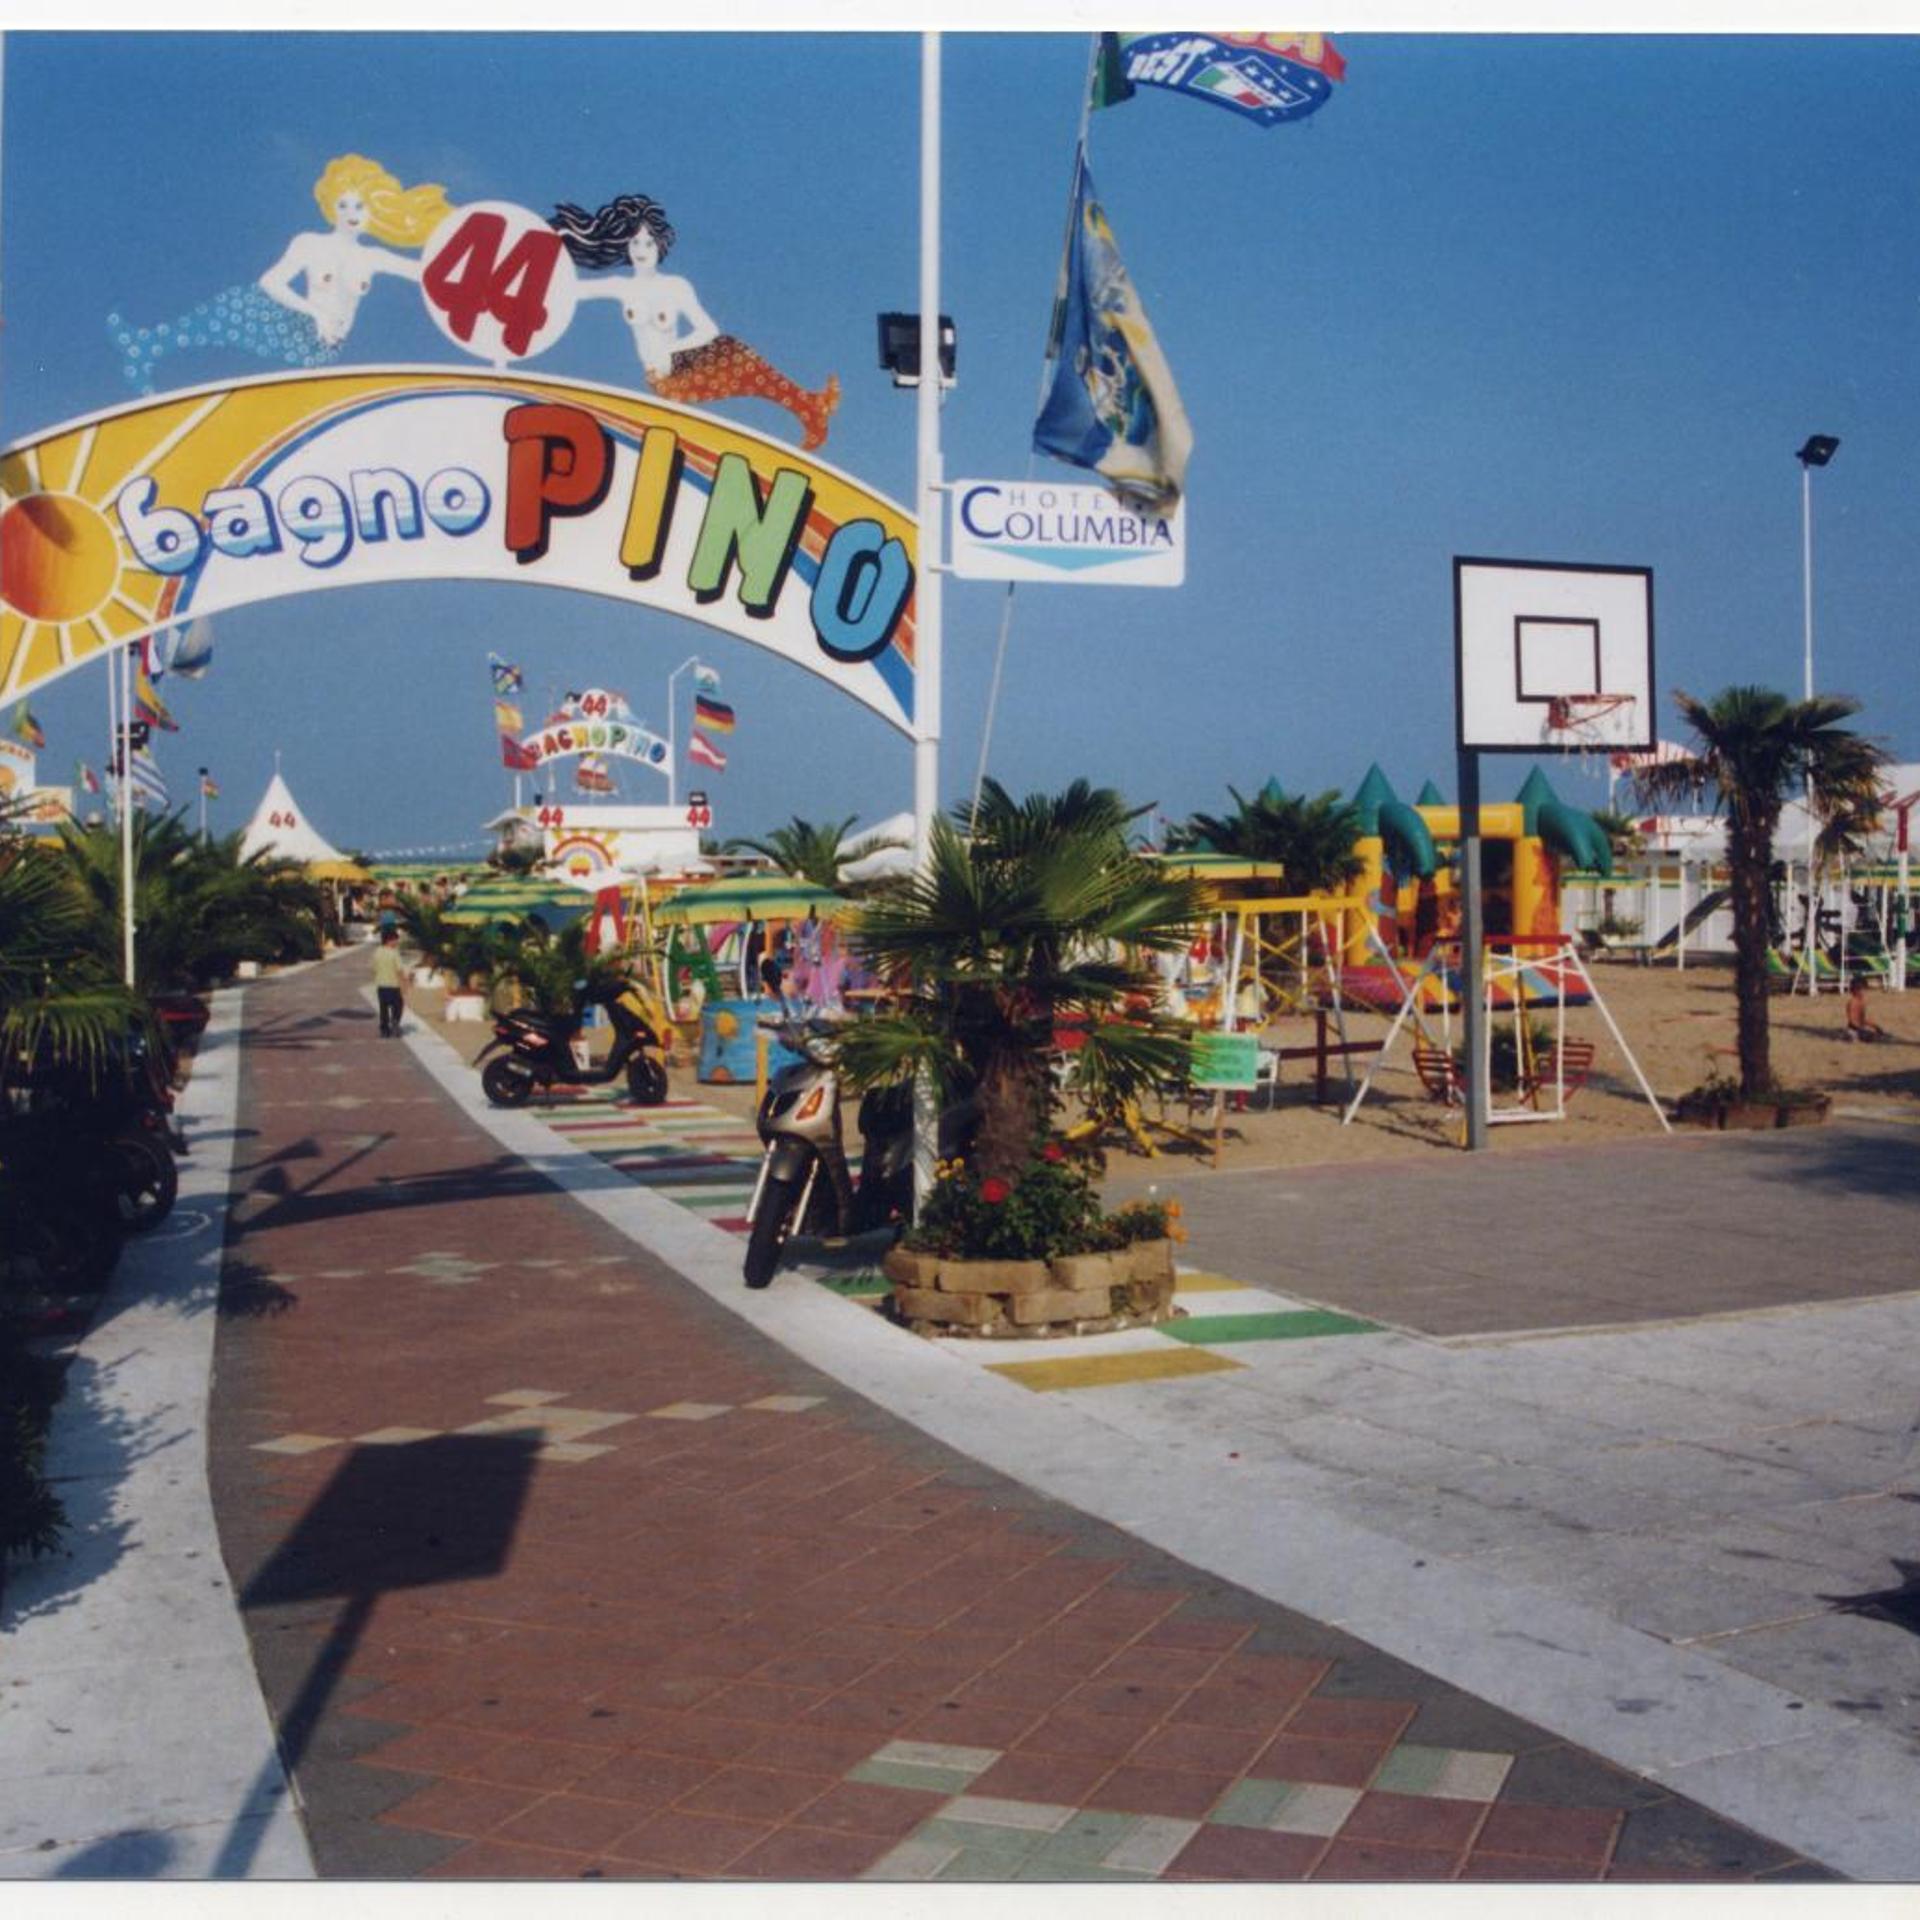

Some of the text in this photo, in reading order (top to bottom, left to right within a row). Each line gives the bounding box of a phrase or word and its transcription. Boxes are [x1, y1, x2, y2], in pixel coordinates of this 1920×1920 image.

[422, 211, 563, 357] 44
[1008, 489, 1128, 513] HOTE
[960, 485, 1175, 547] COLUMBIA
[117, 402, 917, 663] bagno PINO
[582, 694, 608, 717] 44
[269, 810, 297, 829] 44
[538, 807, 564, 827] 44
[687, 807, 711, 827] 44
